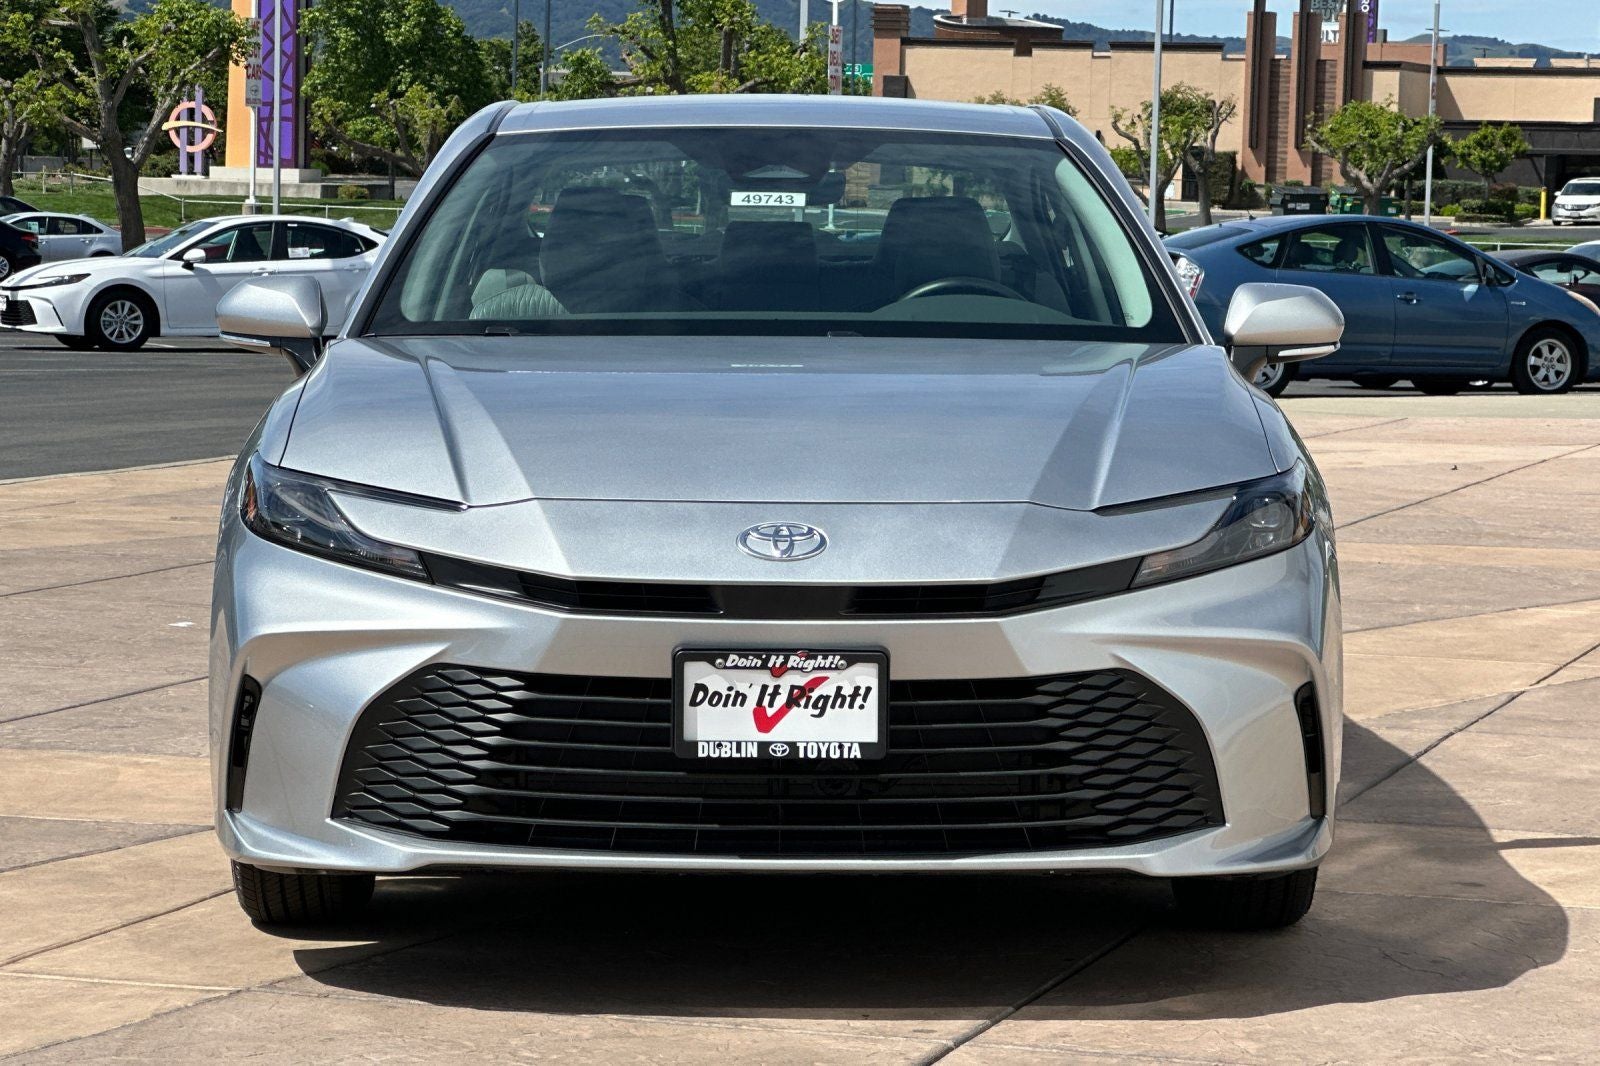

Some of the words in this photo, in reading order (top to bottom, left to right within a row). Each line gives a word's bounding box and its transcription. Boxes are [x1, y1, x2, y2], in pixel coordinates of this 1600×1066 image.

[741, 194, 795, 205] 49743
[725, 654, 766, 668] Doin'
[769, 654, 782, 668] It
[787, 654, 839, 672] Right!
[688, 682, 753, 708] Doin'
[755, 683, 782, 708] It
[785, 684, 873, 718] Right!
[697, 741, 758, 758] DUBLIN
[796, 741, 862, 759] TOYOTA
